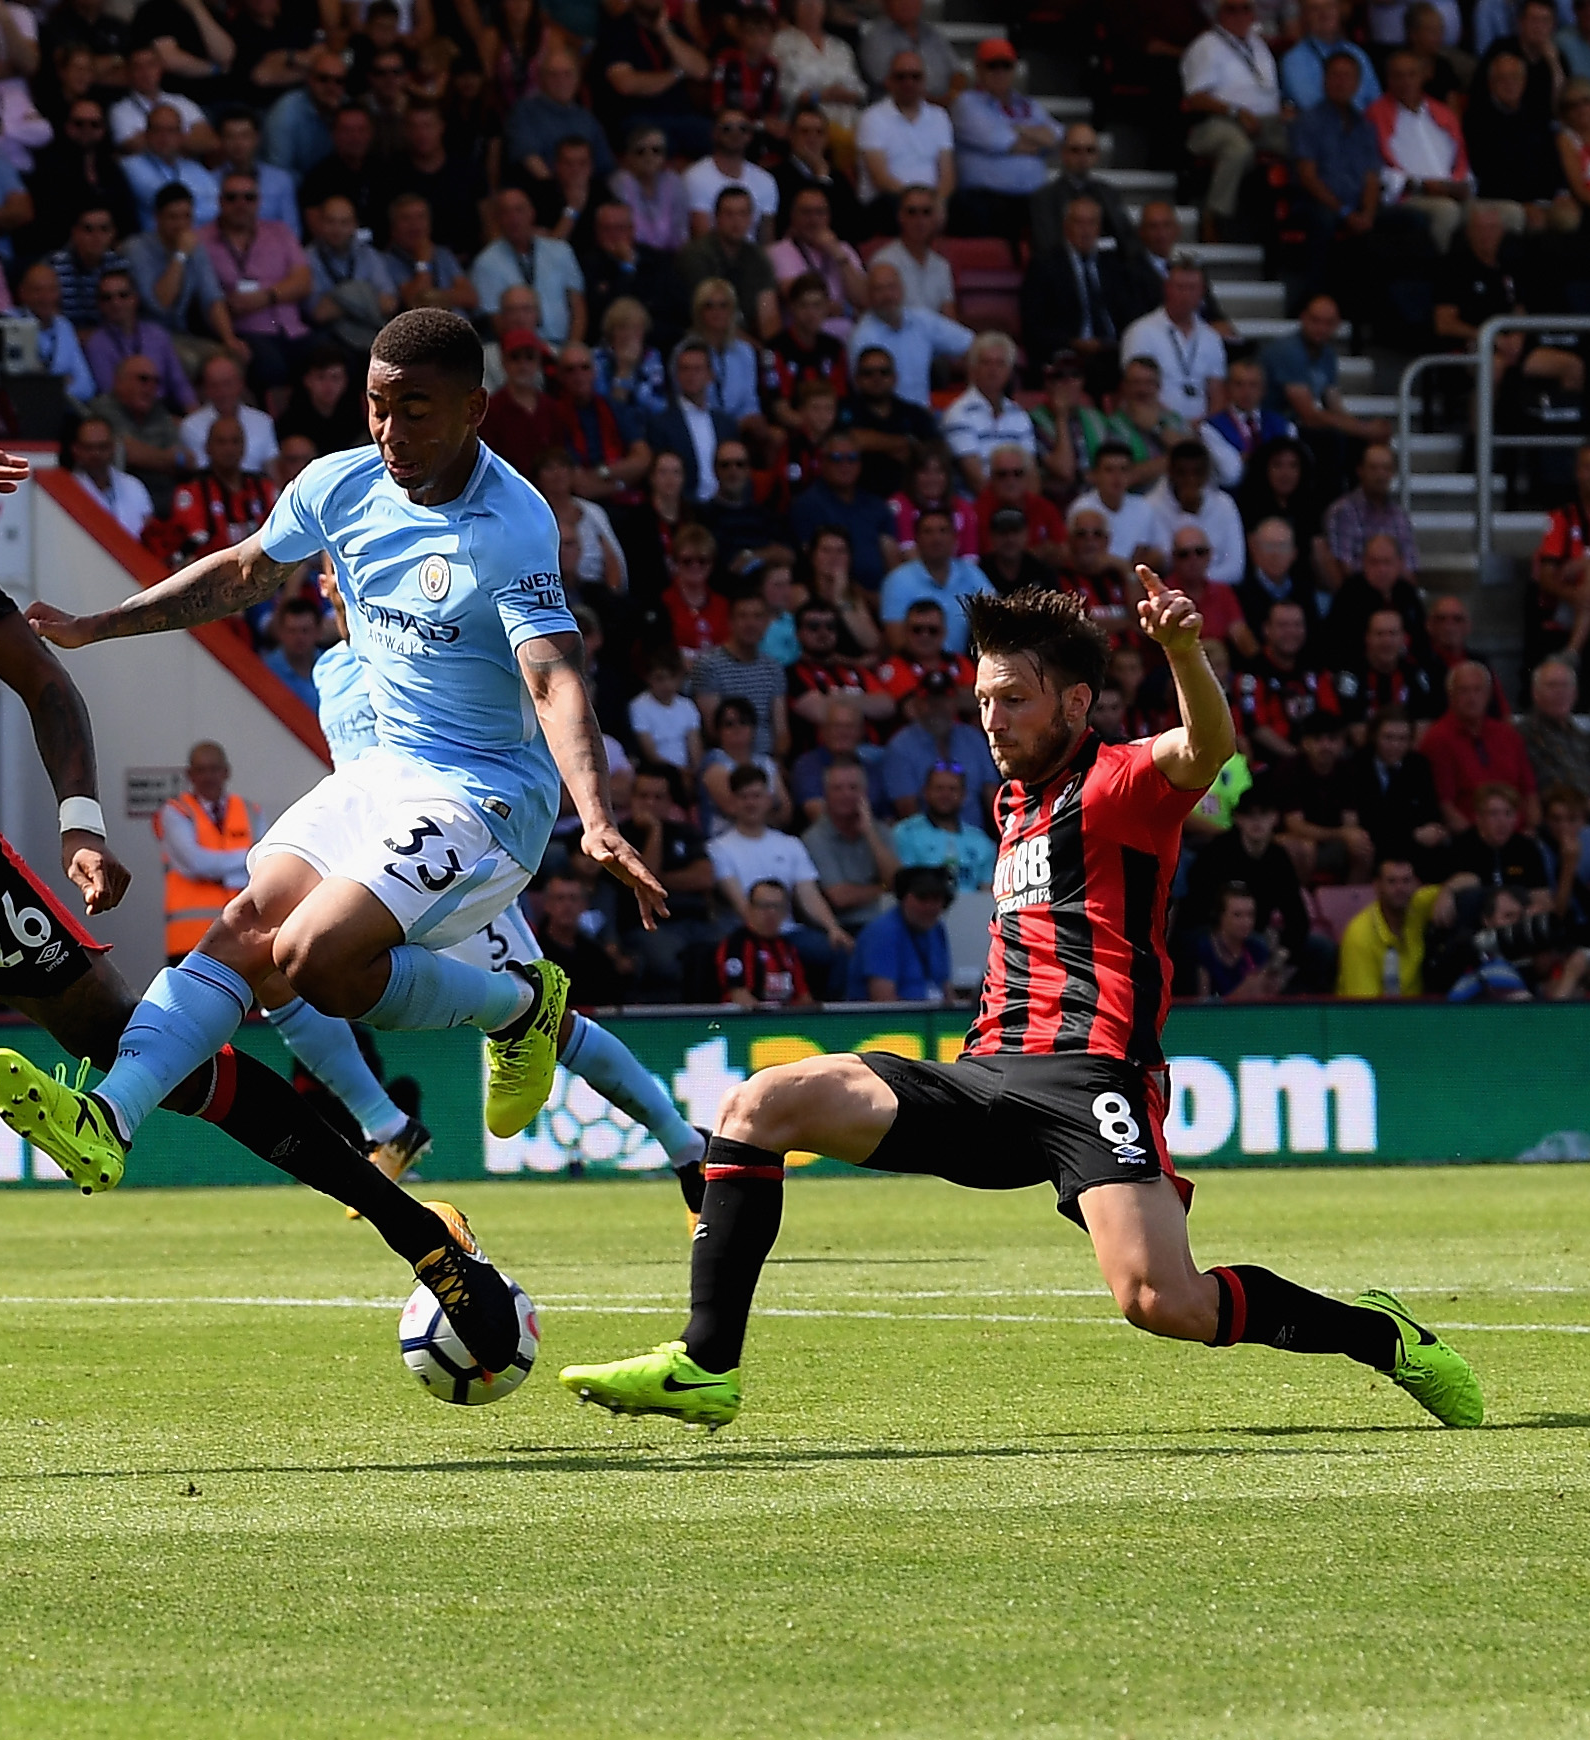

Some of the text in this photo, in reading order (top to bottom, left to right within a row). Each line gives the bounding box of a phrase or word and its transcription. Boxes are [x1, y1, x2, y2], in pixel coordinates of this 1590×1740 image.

[519, 572, 562, 592] NEXE
[533, 589, 562, 606] TIR
[367, 627, 431, 657] AIRWAYS
[383, 816, 464, 892] 33
[45, 950, 70, 973] umbro
[117, 1048, 141, 1058] ITY
[1092, 1091, 1140, 1145] 8
